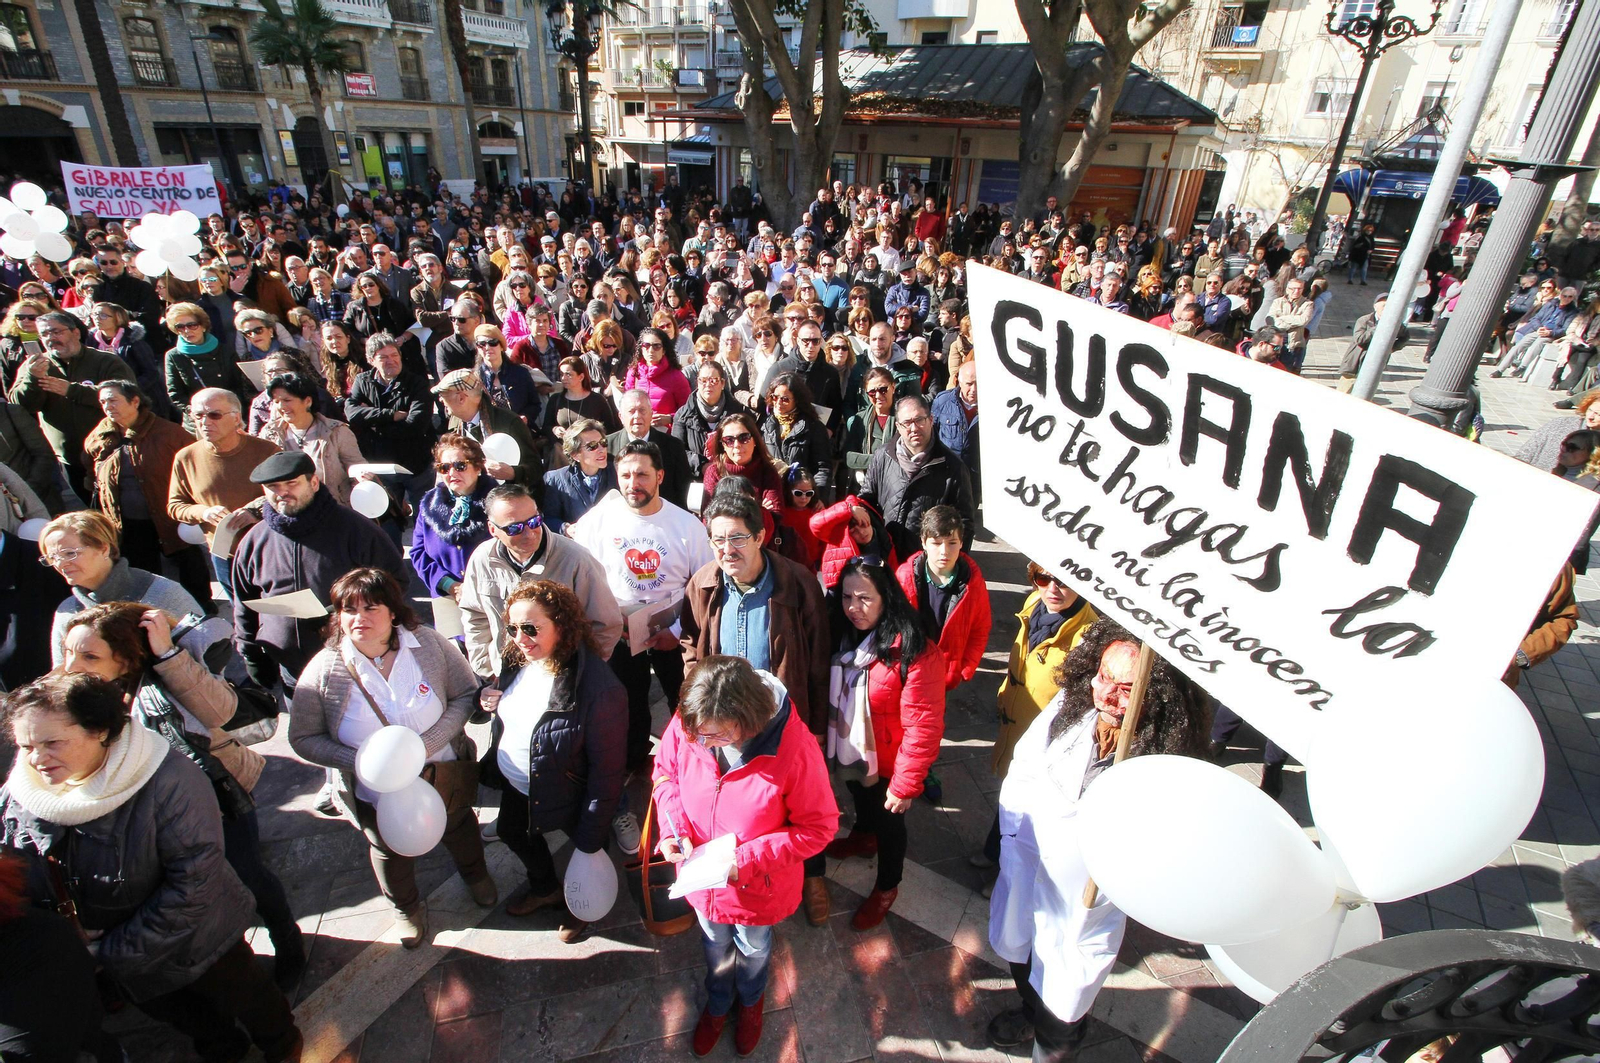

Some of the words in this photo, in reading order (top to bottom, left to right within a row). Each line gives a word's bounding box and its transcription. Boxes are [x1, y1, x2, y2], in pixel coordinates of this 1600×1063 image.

[74, 186, 125, 199] NUEVO
[128, 187, 192, 200] CENTRO
[196, 187, 217, 199] DE
[80, 200, 143, 217] SALUD
[152, 200, 182, 216] YA
[990, 299, 1476, 597] GUSANA
[1006, 396, 1055, 442] no
[1321, 585, 1436, 659] la
[641, 537, 655, 547] POR
[1004, 476, 1105, 550] sorda
[1111, 551, 1152, 588] ni
[1158, 572, 1206, 619] la
[627, 556, 658, 570] Yeah!!
[647, 573, 667, 590] DIGNA
